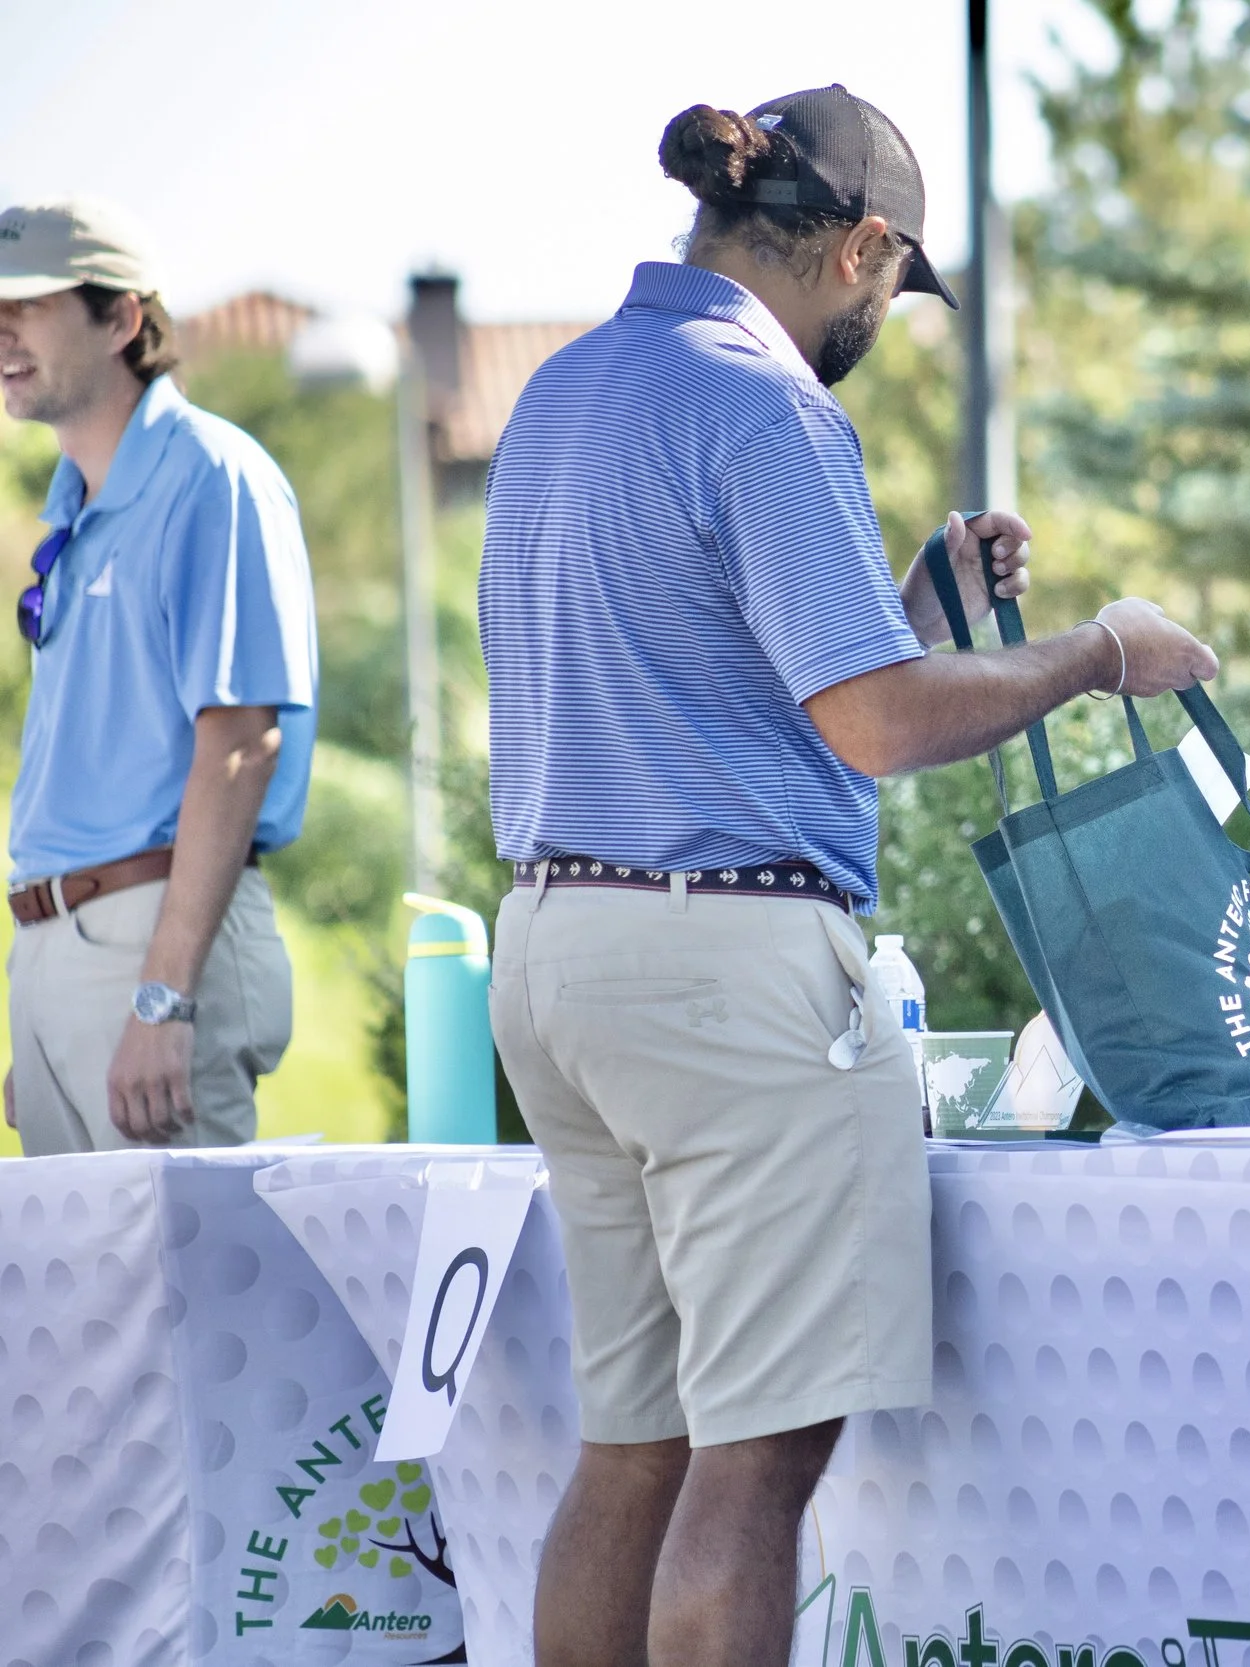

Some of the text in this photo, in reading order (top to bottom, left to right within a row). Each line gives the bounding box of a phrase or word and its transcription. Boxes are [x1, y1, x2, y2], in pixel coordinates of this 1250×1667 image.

[422, 1246, 489, 1407] Q
[236, 1529, 289, 1637] THE
[352, 1610, 432, 1632] Antero
